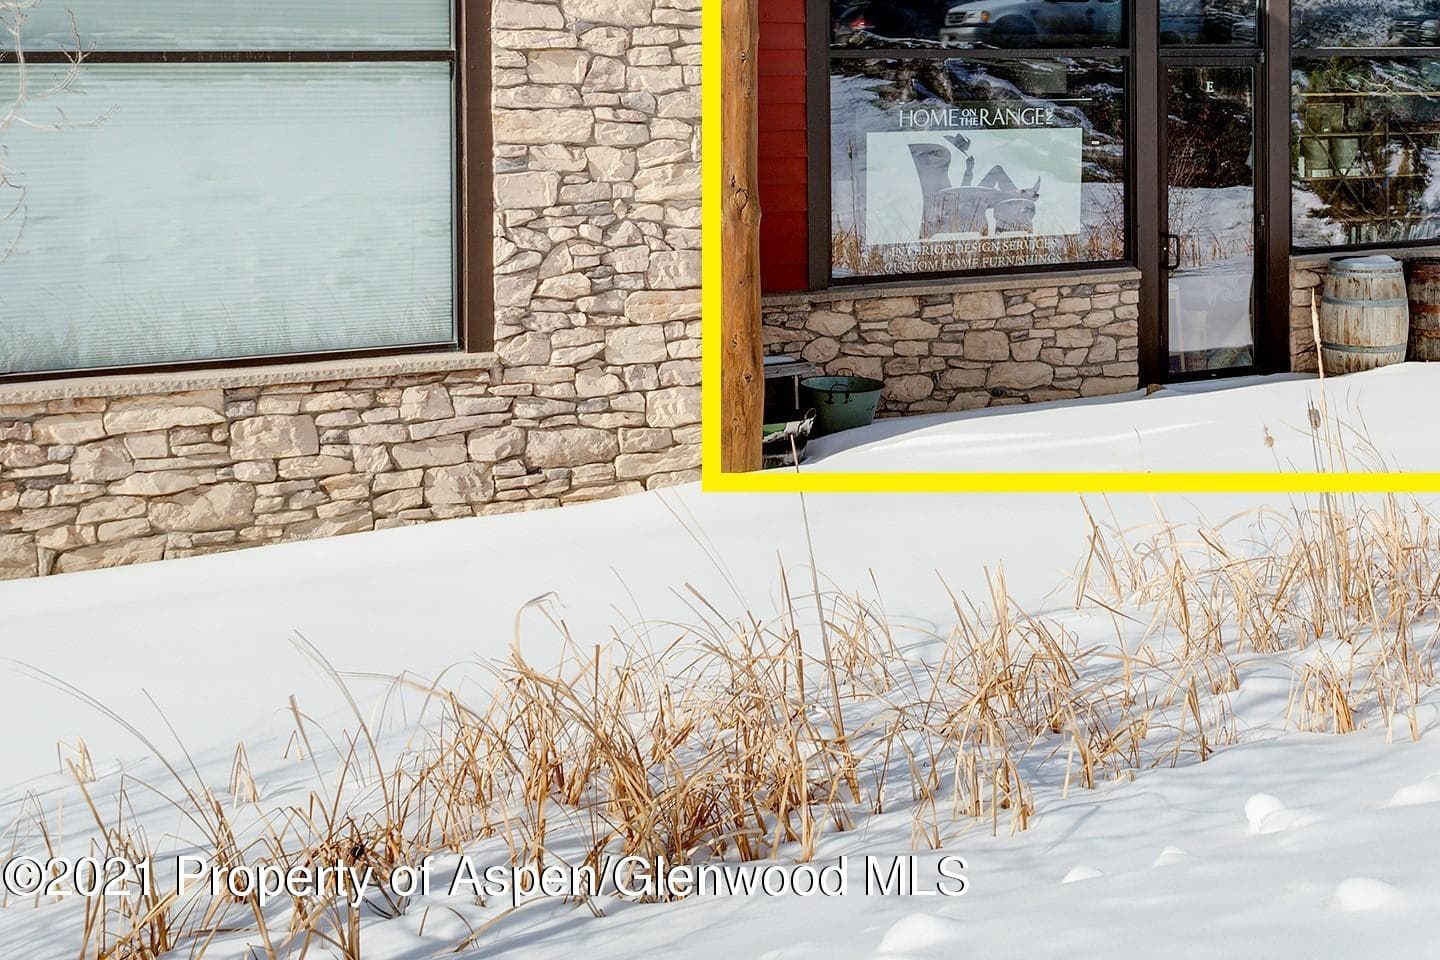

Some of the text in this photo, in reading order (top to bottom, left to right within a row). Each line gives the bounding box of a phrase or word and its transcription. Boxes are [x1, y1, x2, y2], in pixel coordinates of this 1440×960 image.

[900, 108, 959, 127] HOME
[960, 117, 979, 126] THE
[961, 108, 976, 117] ON
[980, 107, 1044, 126] RANGE
[889, 239, 1056, 257] INTERIOR DESIGN SERVICES
[884, 254, 1061, 273] CUSTOM HOME FURNISHINGS
